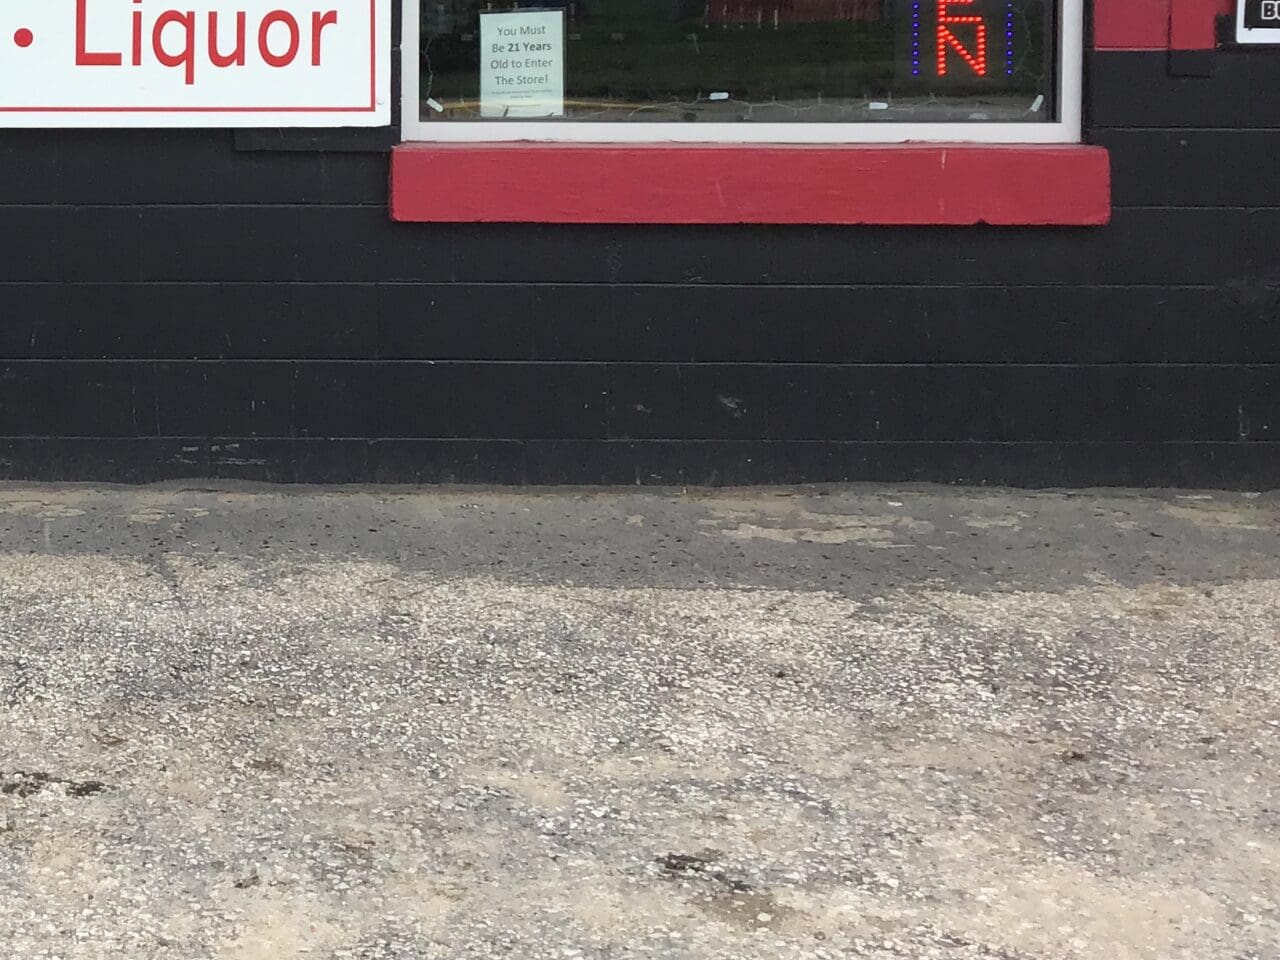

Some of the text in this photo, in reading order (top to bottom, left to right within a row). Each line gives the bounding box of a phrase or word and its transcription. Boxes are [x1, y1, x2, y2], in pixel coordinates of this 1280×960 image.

[497, 26, 545, 36] You Must
[492, 42, 552, 53] Be 21 Years
[490, 58, 552, 69] Old to Enter
[495, 74, 548, 85] The Store!
